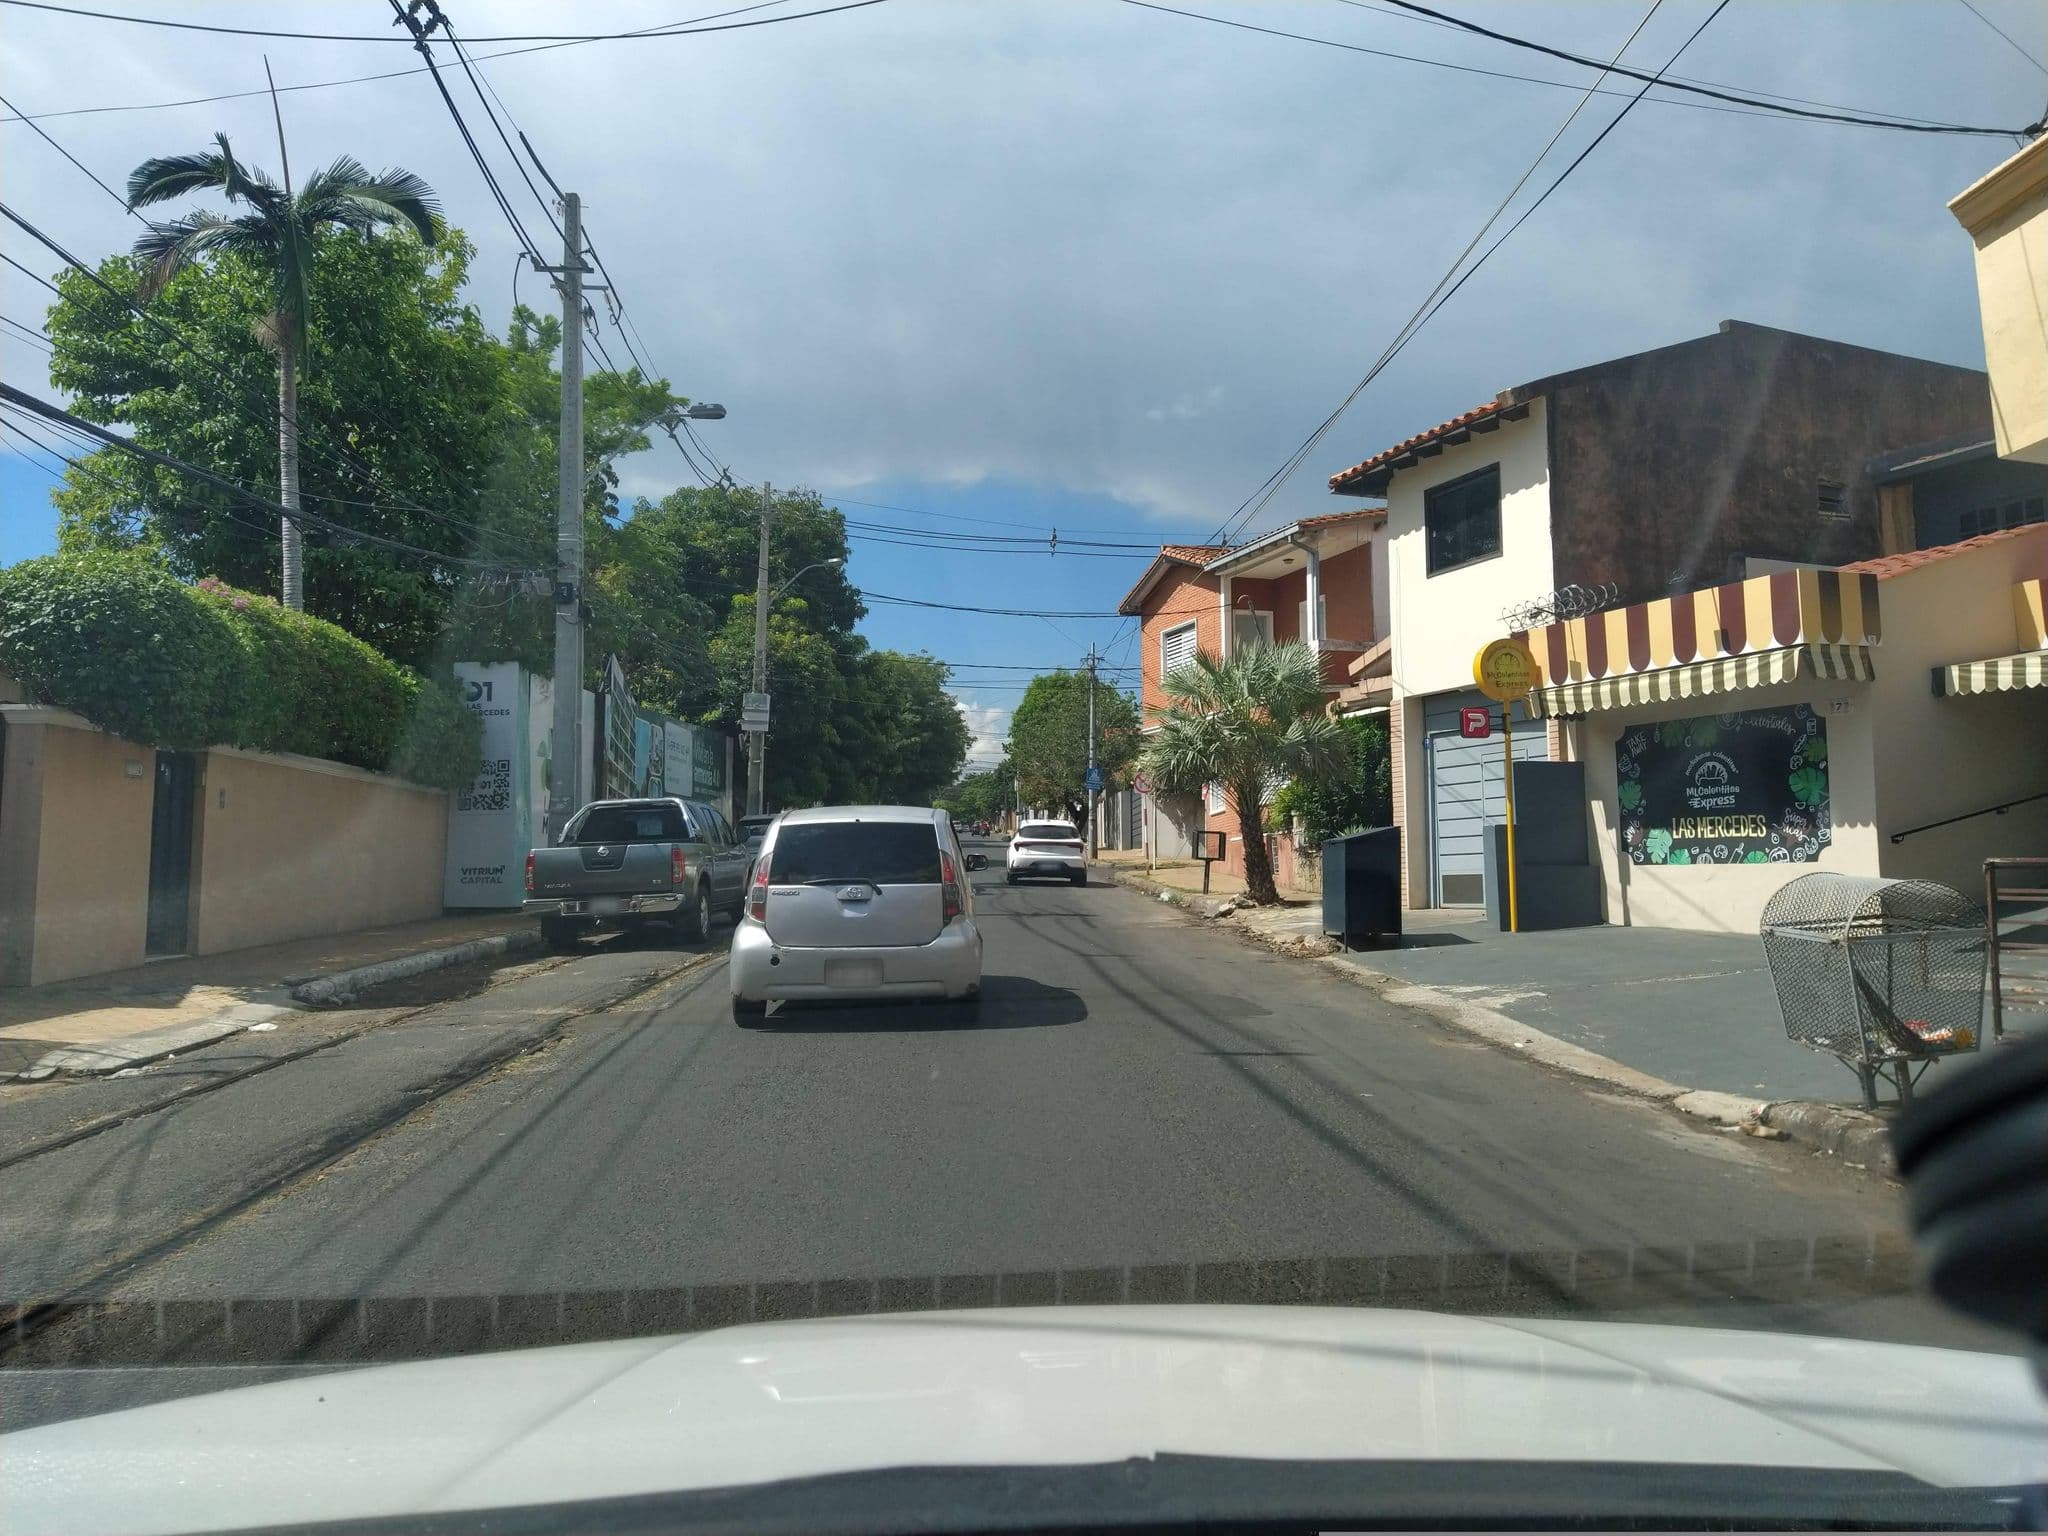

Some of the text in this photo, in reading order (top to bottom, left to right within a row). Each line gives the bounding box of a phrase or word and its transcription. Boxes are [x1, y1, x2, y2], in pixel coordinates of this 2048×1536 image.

[1626, 732, 1647, 750] TAKE
[1691, 795, 1736, 810] Express
[1672, 815, 1767, 839] LAS MERCEDES
[461, 866, 505, 876] VITRIUM
[461, 876, 504, 884] CAPITAL
